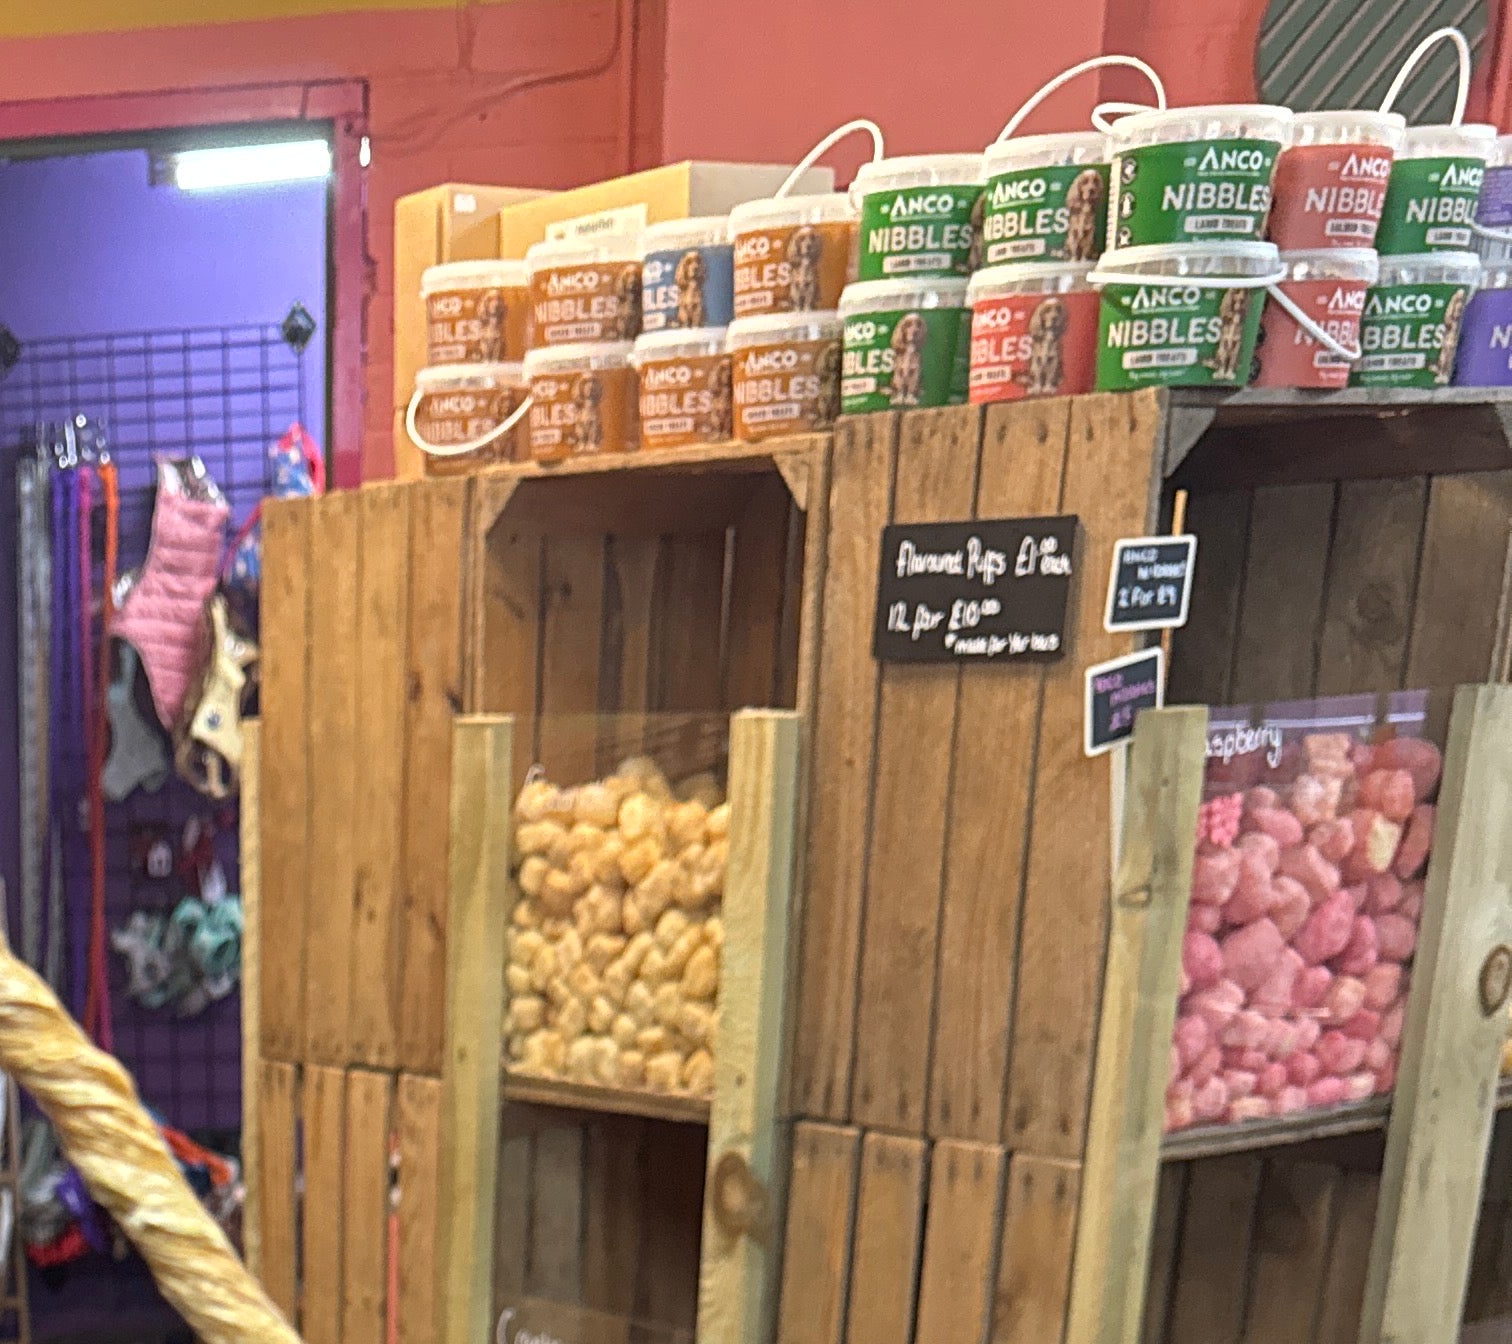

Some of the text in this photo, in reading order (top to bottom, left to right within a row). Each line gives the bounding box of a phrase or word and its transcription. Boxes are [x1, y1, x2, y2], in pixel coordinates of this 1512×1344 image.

[1197, 146, 1264, 171] ANCO
[992, 178, 1048, 207] ANCO
[1161, 183, 1272, 212] NIBBLES
[890, 194, 955, 218] ANCO
[869, 224, 974, 253] NIBBLES
[1129, 286, 1201, 310] ANCO
[1365, 293, 1432, 317] ANCO
[1107, 317, 1222, 348] NIBBLES
[1363, 325, 1446, 351] BBLES
[746, 350, 799, 375] ANCO
[888, 600, 911, 633] 12
